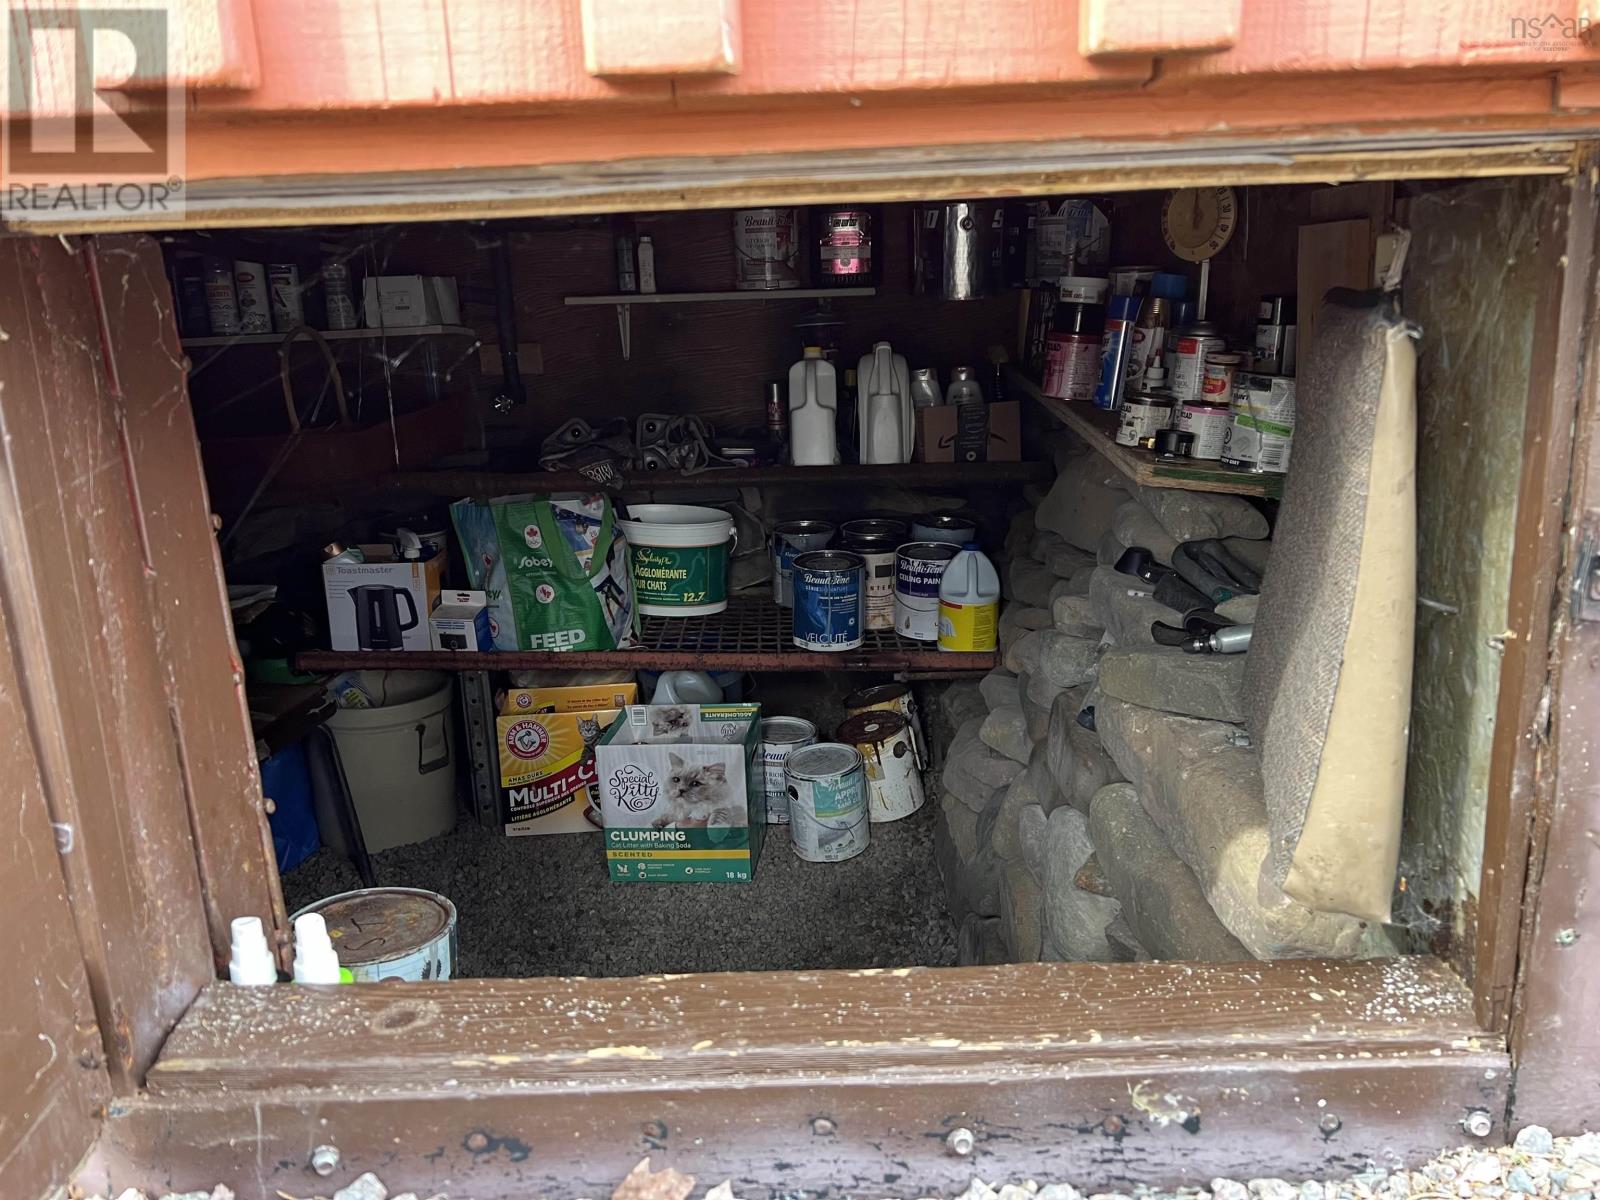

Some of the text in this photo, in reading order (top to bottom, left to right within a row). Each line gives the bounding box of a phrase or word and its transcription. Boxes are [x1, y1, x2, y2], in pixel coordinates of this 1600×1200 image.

[518, 556, 554, 569] Sobey
[336, 566, 393, 575] Toastmaster
[900, 573, 941, 585] CEILING PAIN
[646, 580, 667, 591] CHATS
[530, 629, 586, 649] FEED
[805, 630, 849, 644] VELOUTÉ
[522, 722, 547, 743] HAMMER
[609, 764, 655, 798] Special
[609, 781, 660, 813] Kitty
[610, 830, 686, 842] CLUMPING
[654, 842, 675, 850] Baking
[725, 871, 748, 880] 18 kg
